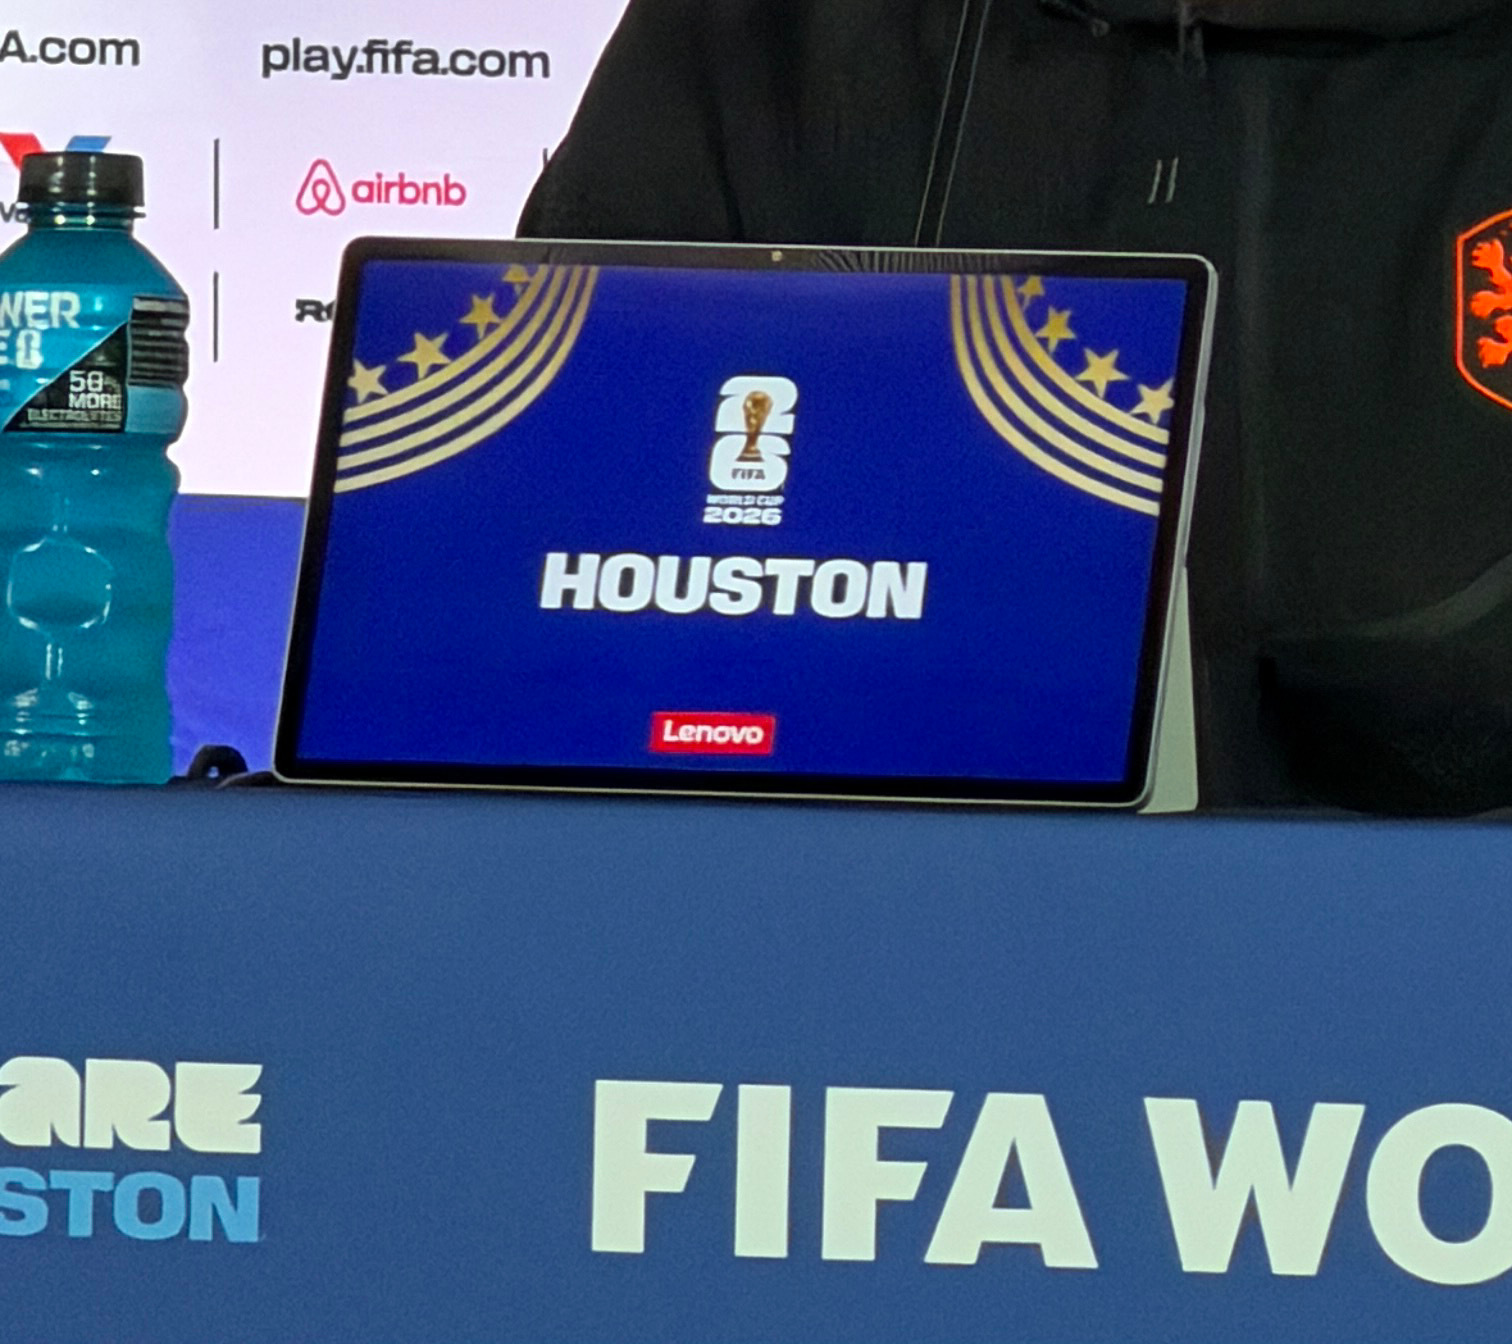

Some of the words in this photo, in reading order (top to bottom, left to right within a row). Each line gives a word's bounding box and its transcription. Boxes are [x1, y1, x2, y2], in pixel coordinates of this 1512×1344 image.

[262, 38, 550, 80] play.fifa.com
[351, 172, 467, 206] airbnb
[703, 507, 783, 526] 2026
[540, 553, 927, 620] HOUSTON
[662, 719, 765, 746] Lenovo
[591, 1079, 1098, 1269] FIFA
